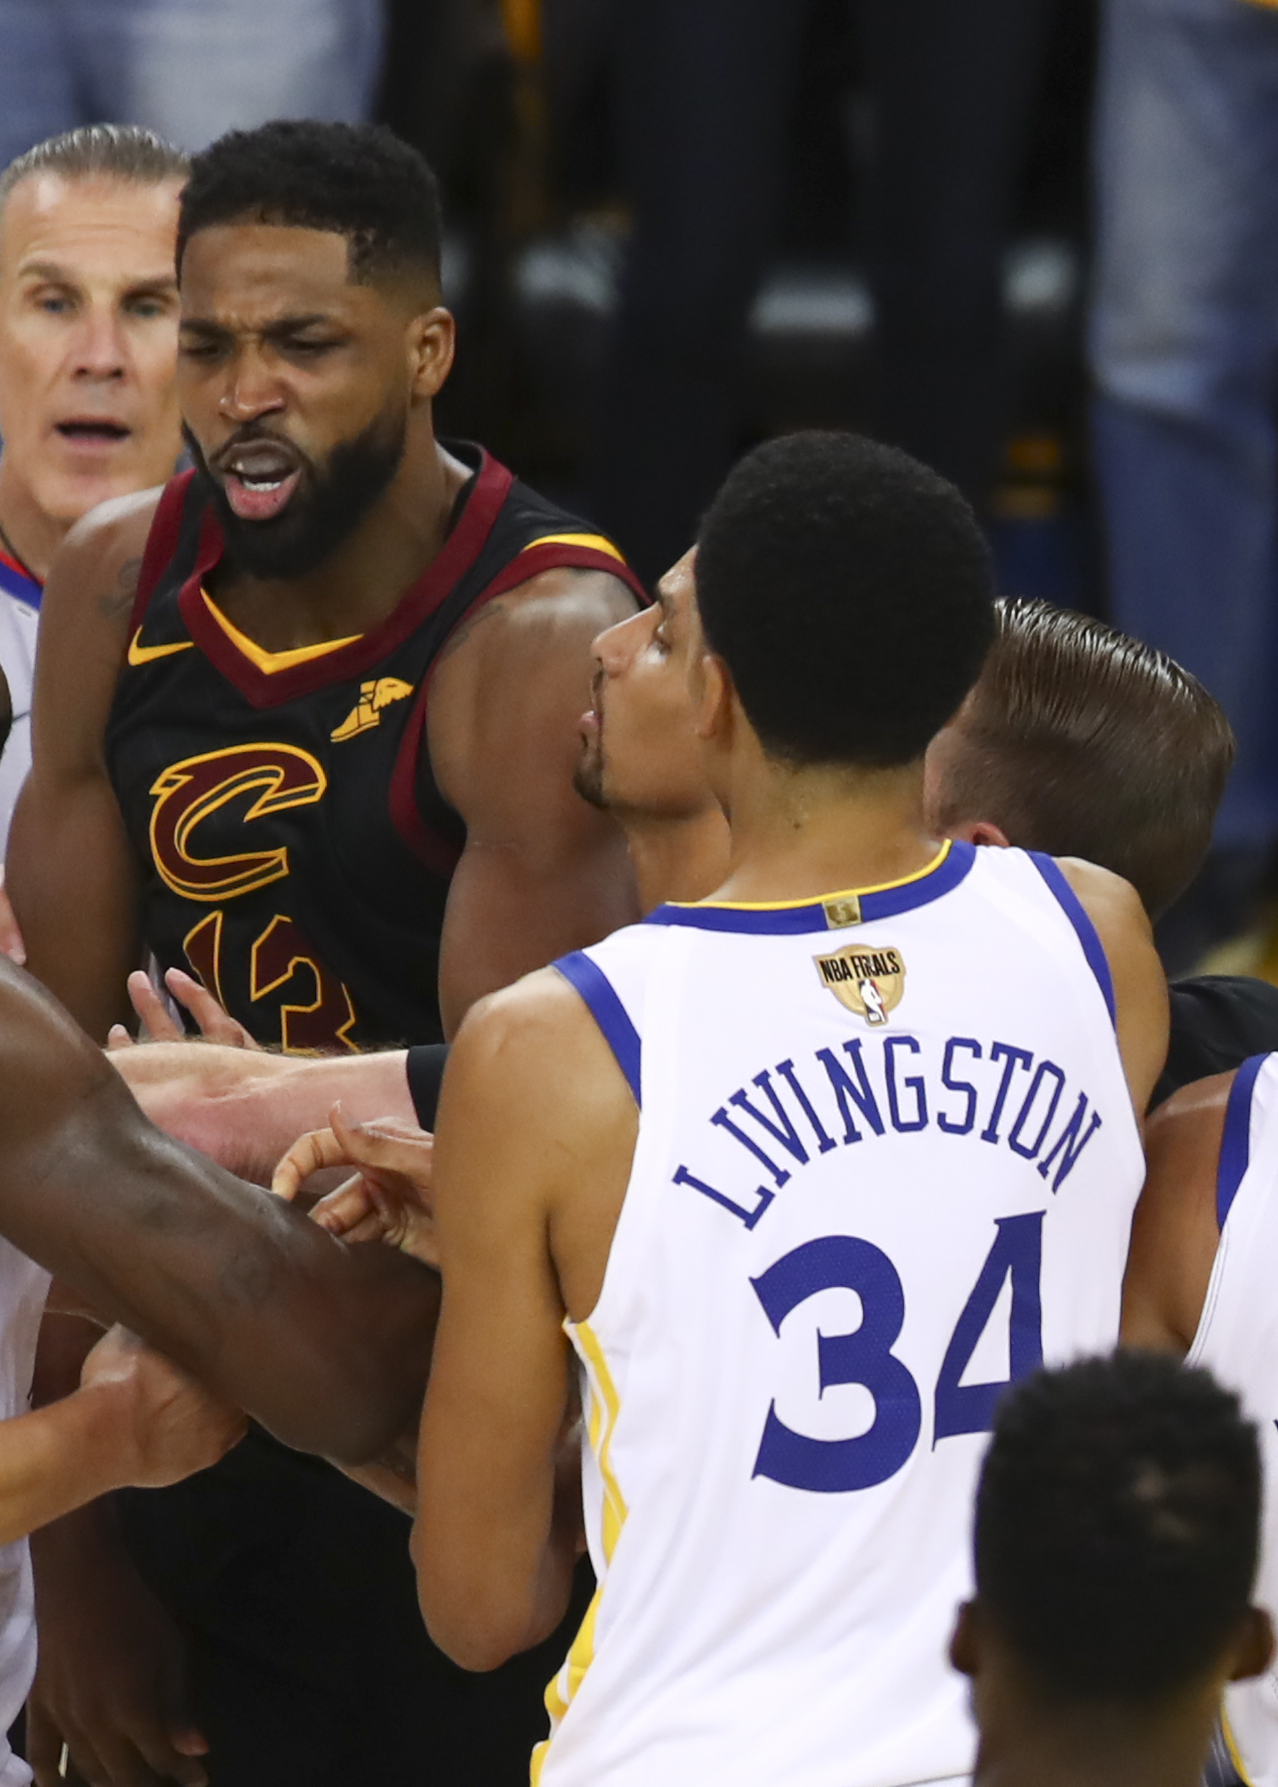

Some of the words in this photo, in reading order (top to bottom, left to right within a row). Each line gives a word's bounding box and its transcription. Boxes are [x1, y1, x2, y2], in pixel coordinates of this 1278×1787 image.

[819, 957, 853, 983] NBA
[850, 951, 901, 979] FINALS
[671, 1035, 1102, 1231] LIVINGSTON
[748, 1209, 1048, 1493] 34
